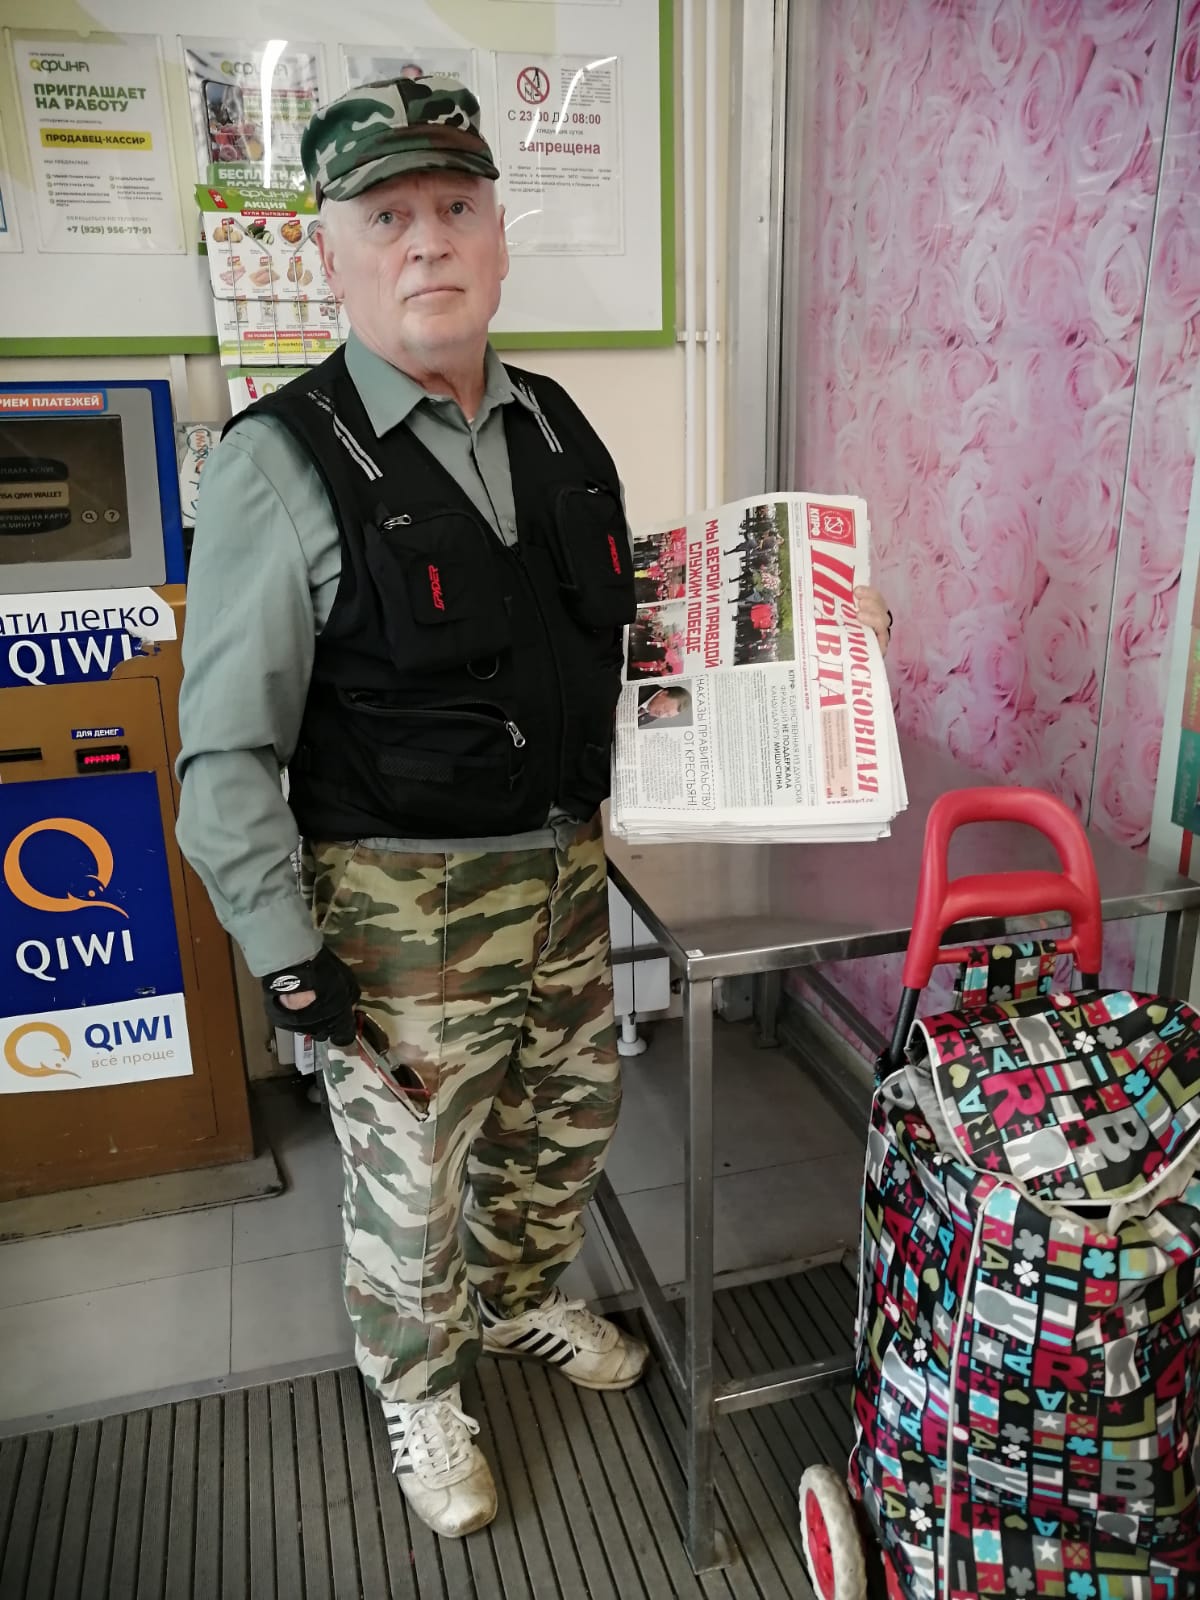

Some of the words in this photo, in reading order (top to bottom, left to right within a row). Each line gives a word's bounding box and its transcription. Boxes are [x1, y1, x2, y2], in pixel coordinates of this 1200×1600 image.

[33, 83, 146, 100] ПРИГЛАШАЕТ
[35, 97, 60, 110] НА
[64, 98, 129, 113] РАБОТУ
[572, 113, 601, 124] 08:00
[45, 133, 146, 145] ПРОДАВЕЦ-КАССИР
[218, 168, 304, 181] БЕСПЛТНА
[244, 201, 287, 210] АКЦИЯ
[32, 395, 100, 407] ПЛАТЕЖЕЙ
[705, 519, 719, 545] МЫ
[810, 507, 821, 536] КПРФ
[688, 541, 702, 599] СЛУЖИМ
[706, 546, 723, 591] ВЕРОЙ
[706, 594, 720, 604] И
[59, 606, 159, 632] легко
[686, 601, 702, 655] ПОБЕДЕ
[704, 606, 723, 669] ПРАВДОЙ
[8, 635, 133, 686] QIWI
[696, 678, 707, 721] НАКАЗЫ
[76, 730, 93, 738] ДЛЯ
[94, 728, 119, 737] ДЕНЕГ
[683, 730, 695, 746] ОТ
[782, 724, 789, 733] НЕ
[698, 725, 711, 807] ПРАВИТЕЛЬСТВУ
[774, 742, 783, 790] МИШУСТИНА
[783, 735, 792, 789] ПОДДЕРЖАЛА
[16, 929, 134, 981] QIWI
[84, 1014, 173, 1052] QIWI
[91, 1054, 118, 1069] всё
[122, 1049, 175, 1066] проще
[1101, 1461, 1155, 1498] B
